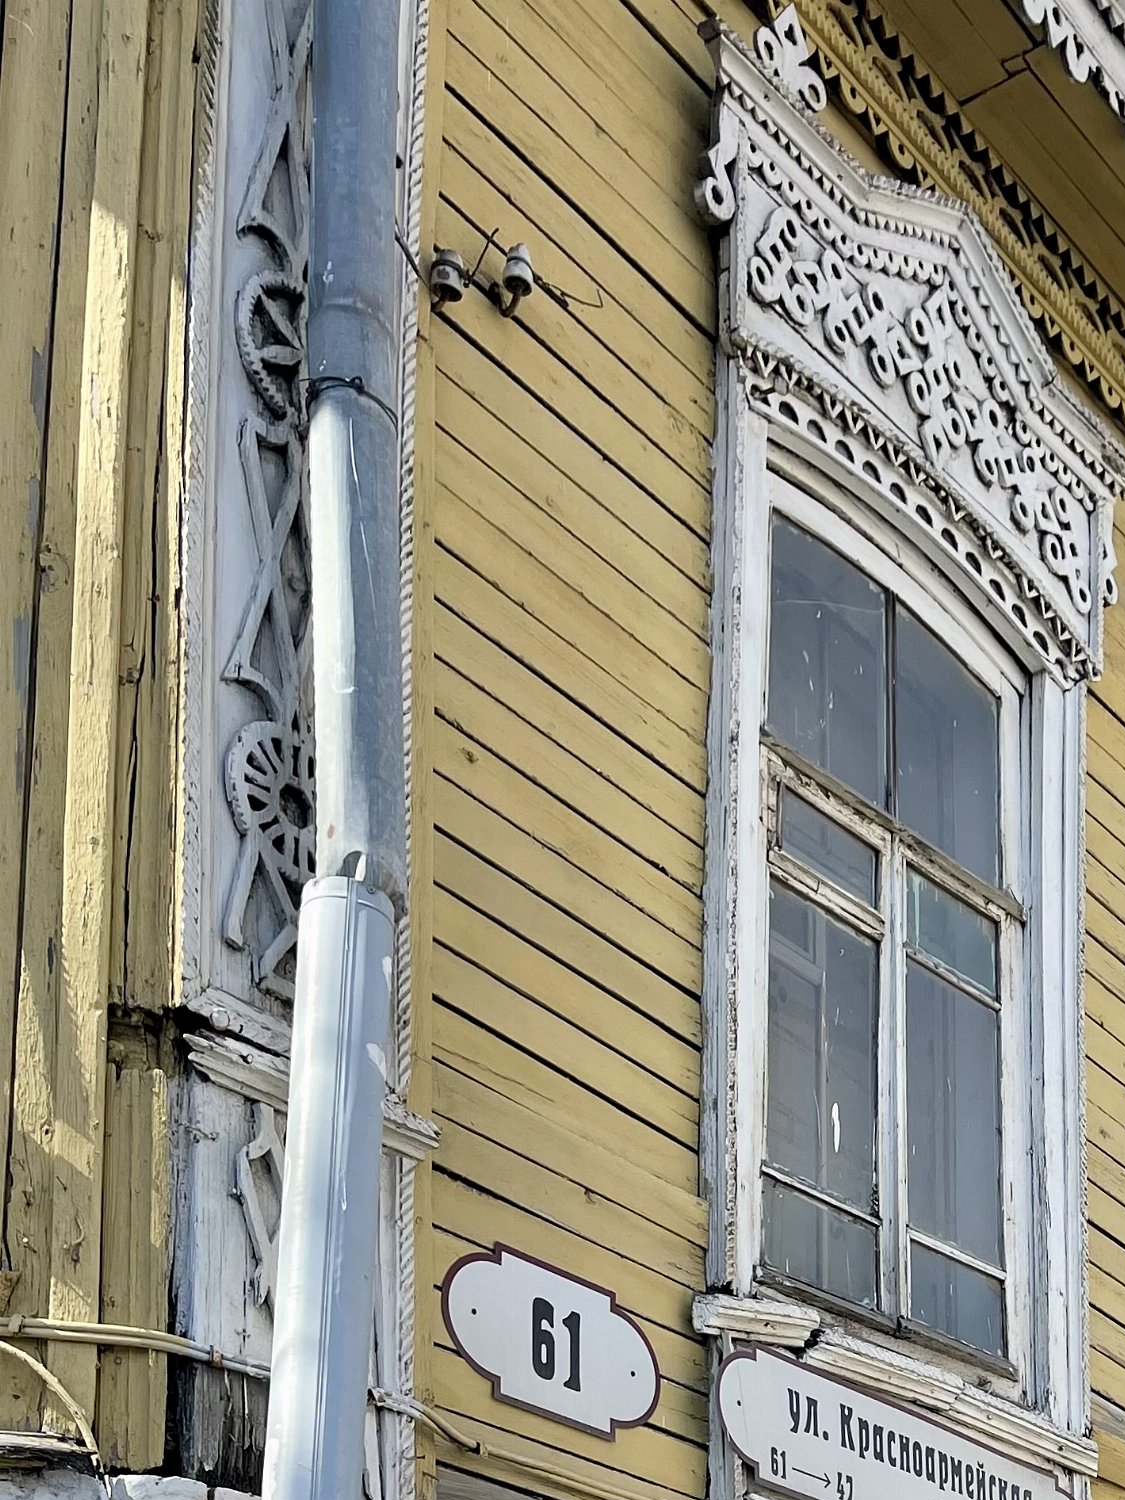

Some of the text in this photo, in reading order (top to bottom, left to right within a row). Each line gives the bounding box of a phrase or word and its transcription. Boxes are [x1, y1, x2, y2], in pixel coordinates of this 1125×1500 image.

[532, 1297, 581, 1392] 61
[787, 1387, 829, 1441] ул.
[771, 1446, 787, 1480] 61
